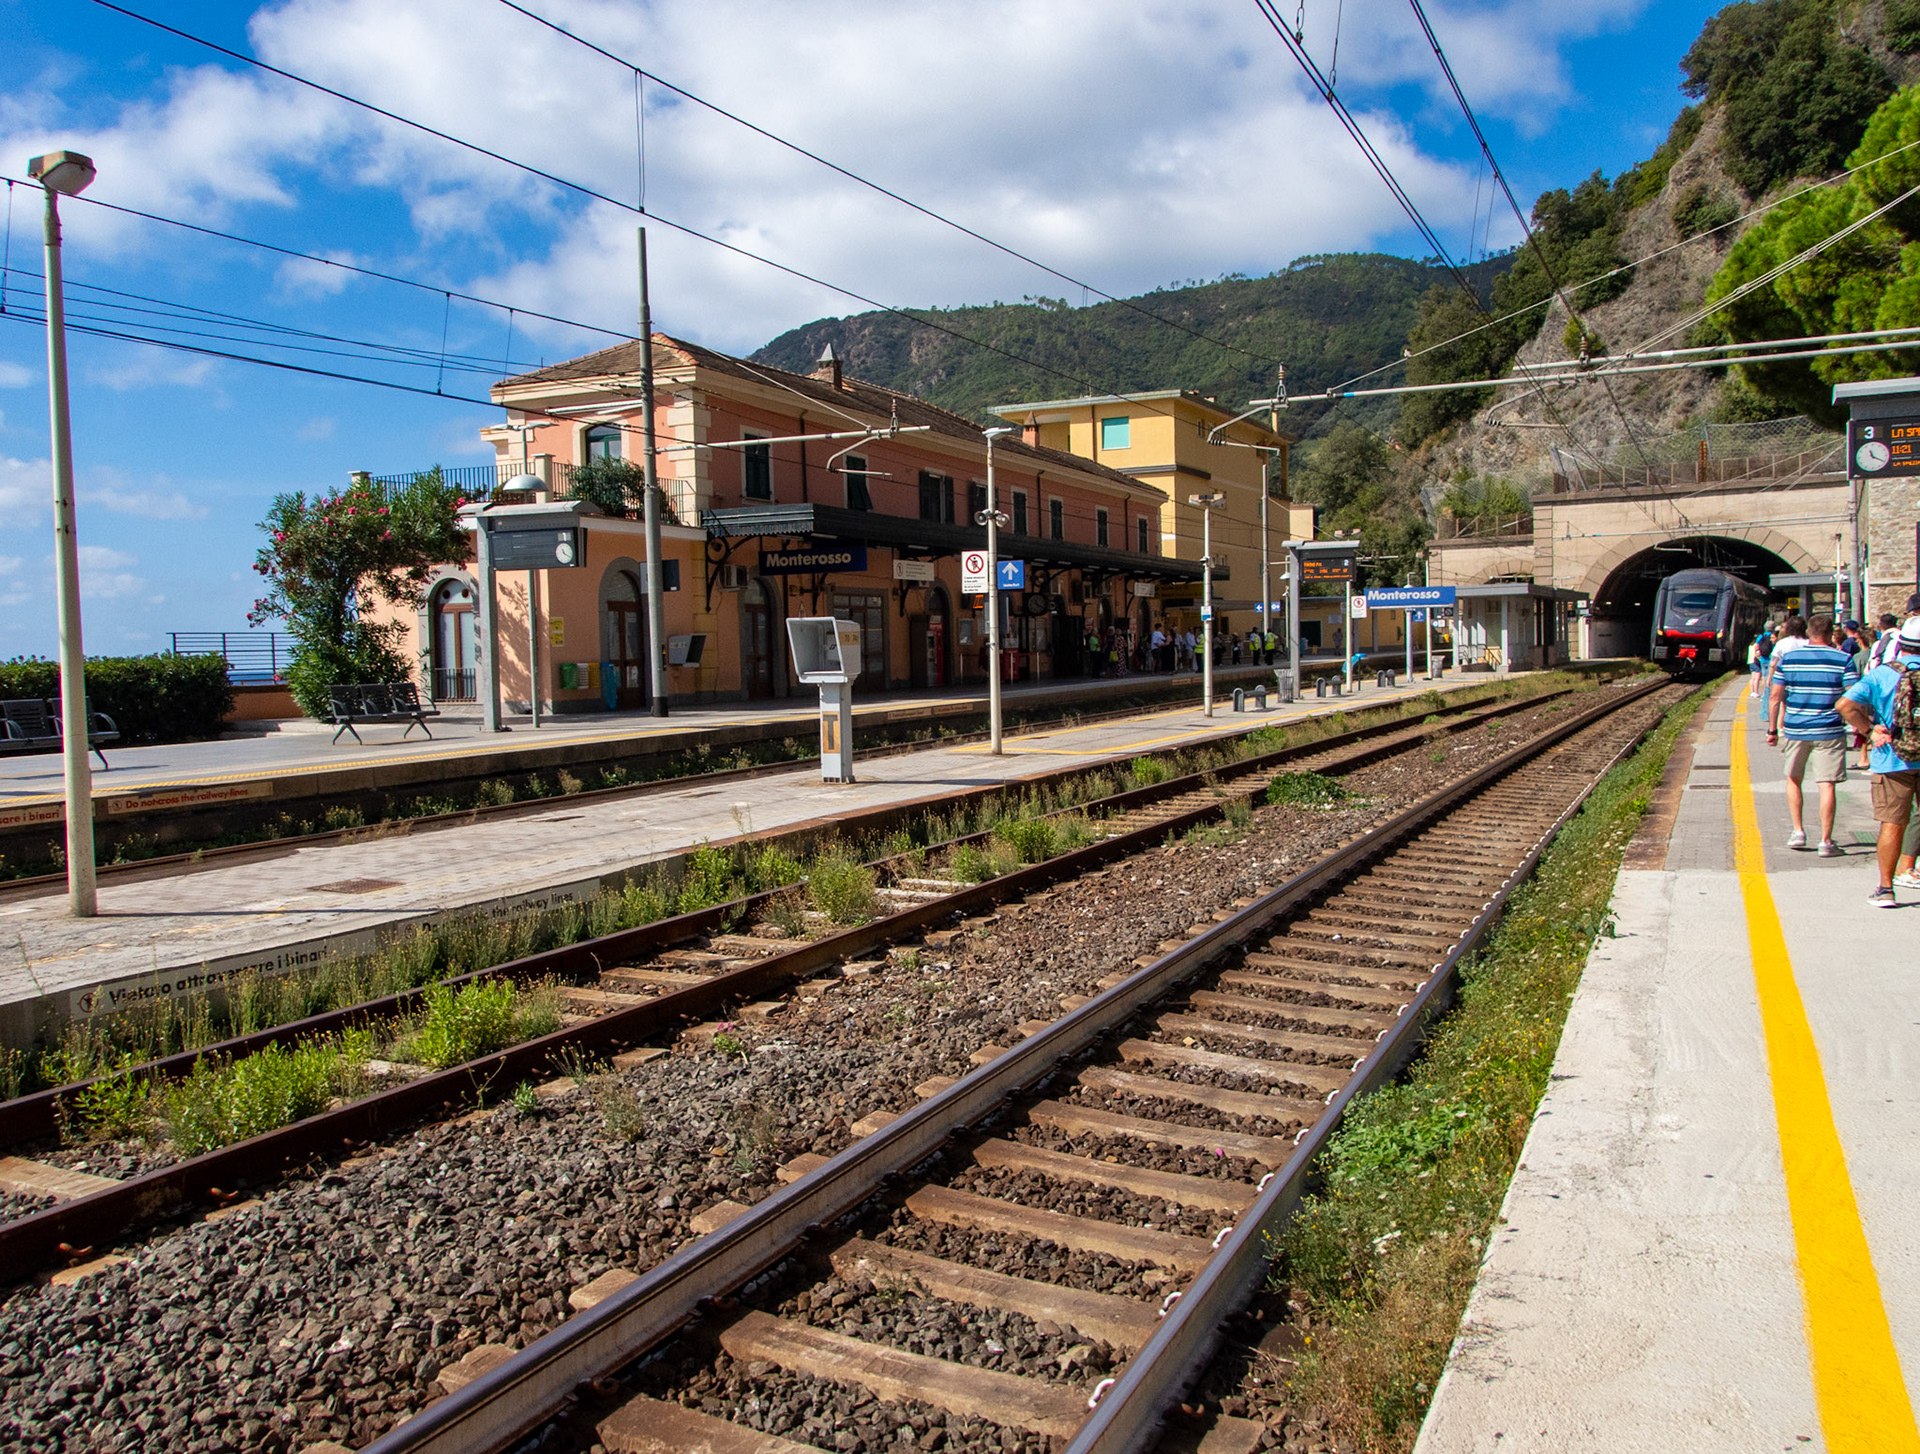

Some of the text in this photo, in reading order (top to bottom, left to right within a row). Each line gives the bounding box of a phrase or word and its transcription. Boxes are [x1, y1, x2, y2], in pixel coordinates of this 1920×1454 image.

[1864, 426, 1875, 440] 3
[766, 552, 852, 568] Monterosso
[1368, 590, 1441, 601] Monterosso
[125, 787, 249, 810] Do not cross the railway lines
[29, 809, 60, 821] binari
[277, 954, 283, 969] i
[285, 945, 329, 967] binari
